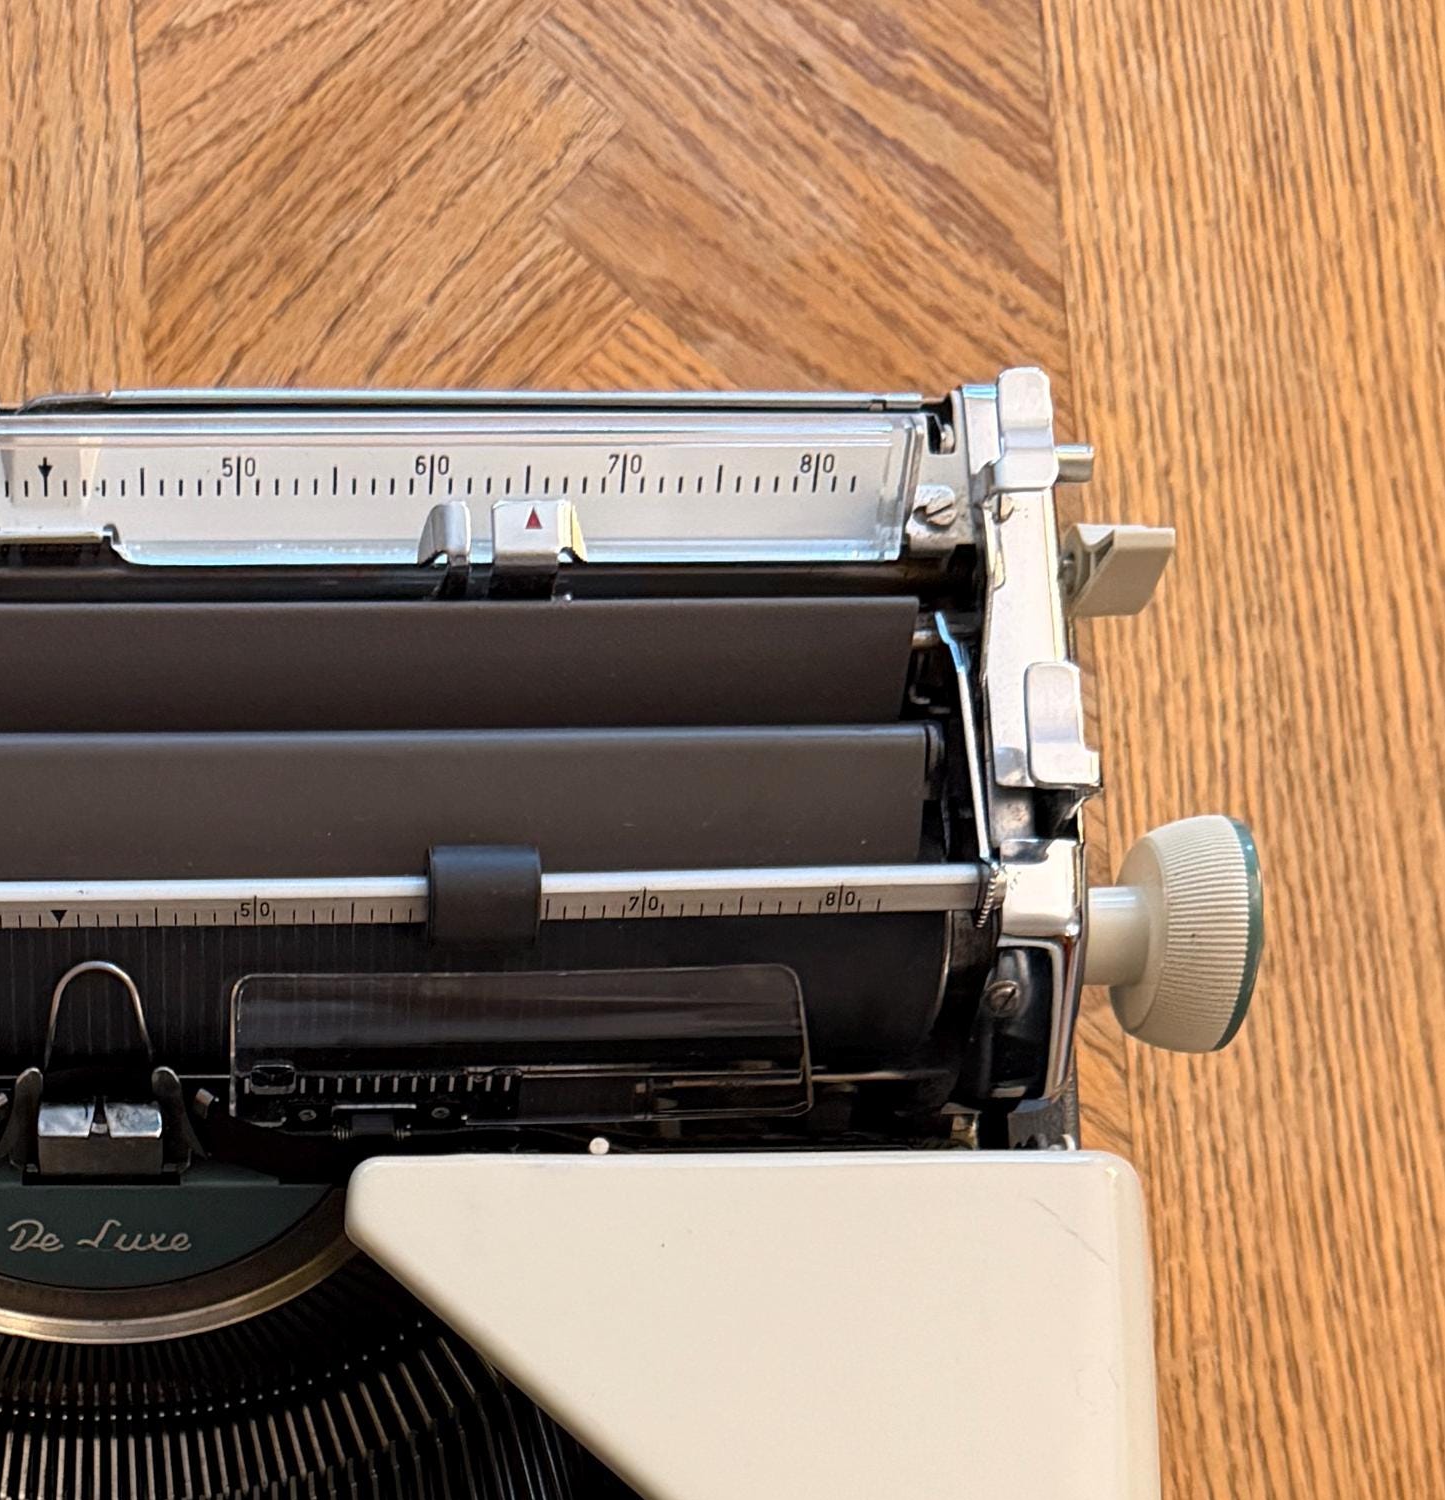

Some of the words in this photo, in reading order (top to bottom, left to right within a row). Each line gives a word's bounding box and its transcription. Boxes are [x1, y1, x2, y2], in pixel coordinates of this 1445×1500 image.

[222, 457, 257, 478] 50
[415, 454, 450, 475] 60
[608, 454, 643, 474] 70
[800, 453, 835, 474] 80
[240, 902, 270, 917] 50
[628, 895, 658, 912] 70
[825, 891, 855, 907] 80
[7, 1218, 64, 1251] De
[77, 1218, 192, 1251] Luxe
